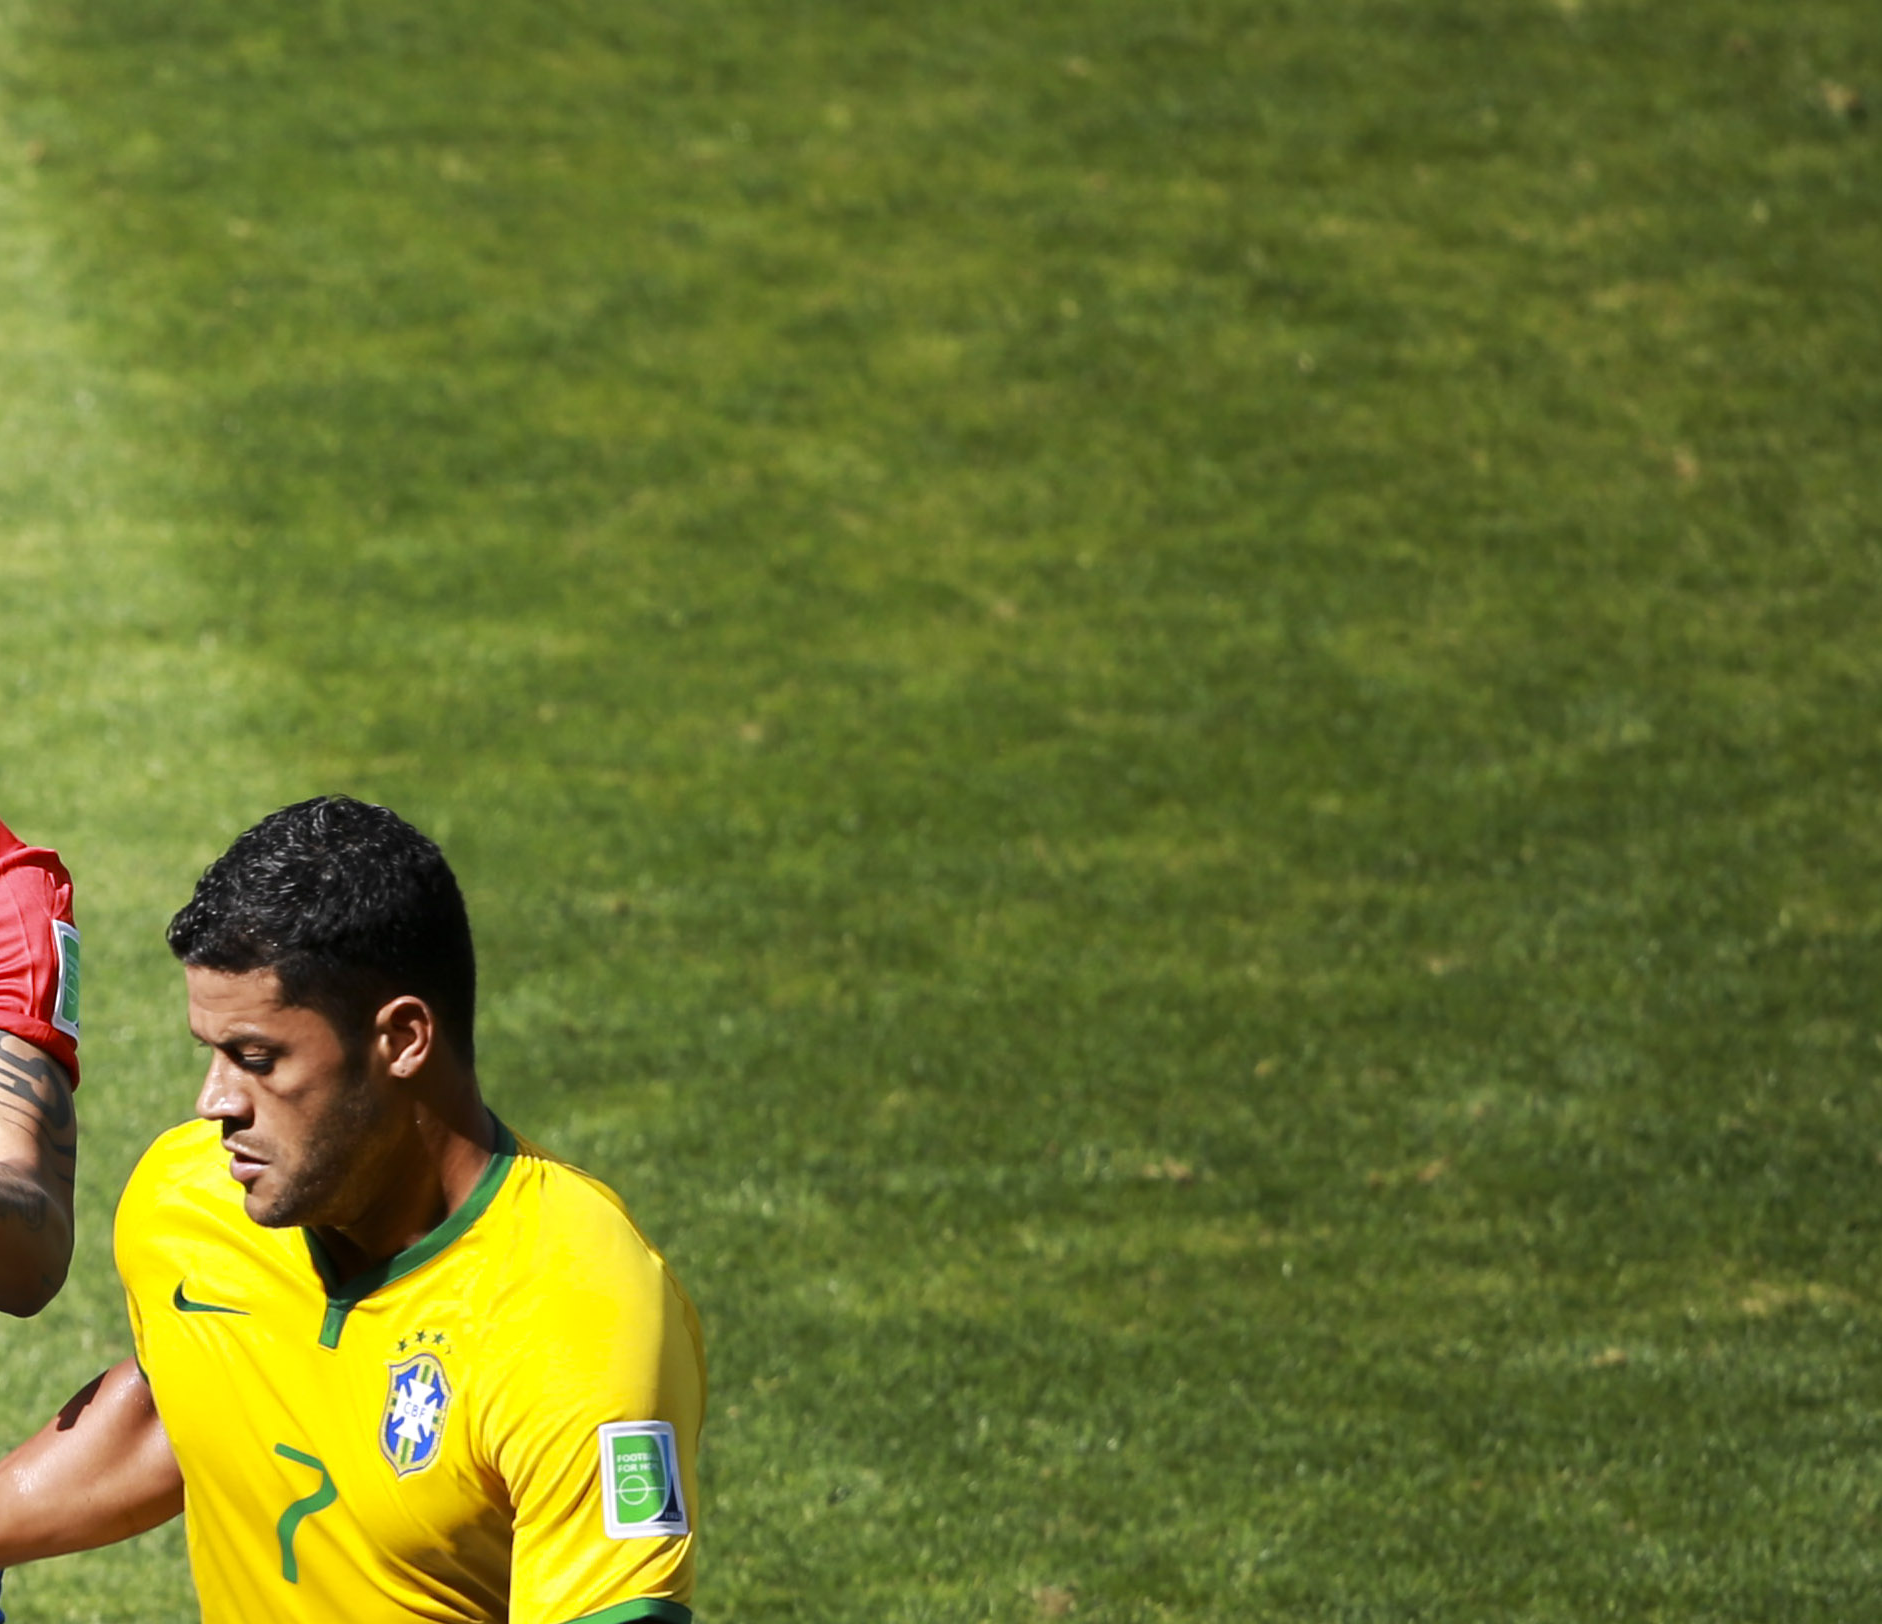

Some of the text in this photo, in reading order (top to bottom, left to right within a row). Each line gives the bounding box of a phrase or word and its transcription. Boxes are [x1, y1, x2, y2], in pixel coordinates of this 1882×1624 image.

[403, 1401, 427, 1419] CBF
[617, 1464, 638, 1473] FOR
[274, 1442, 339, 1585] 7
